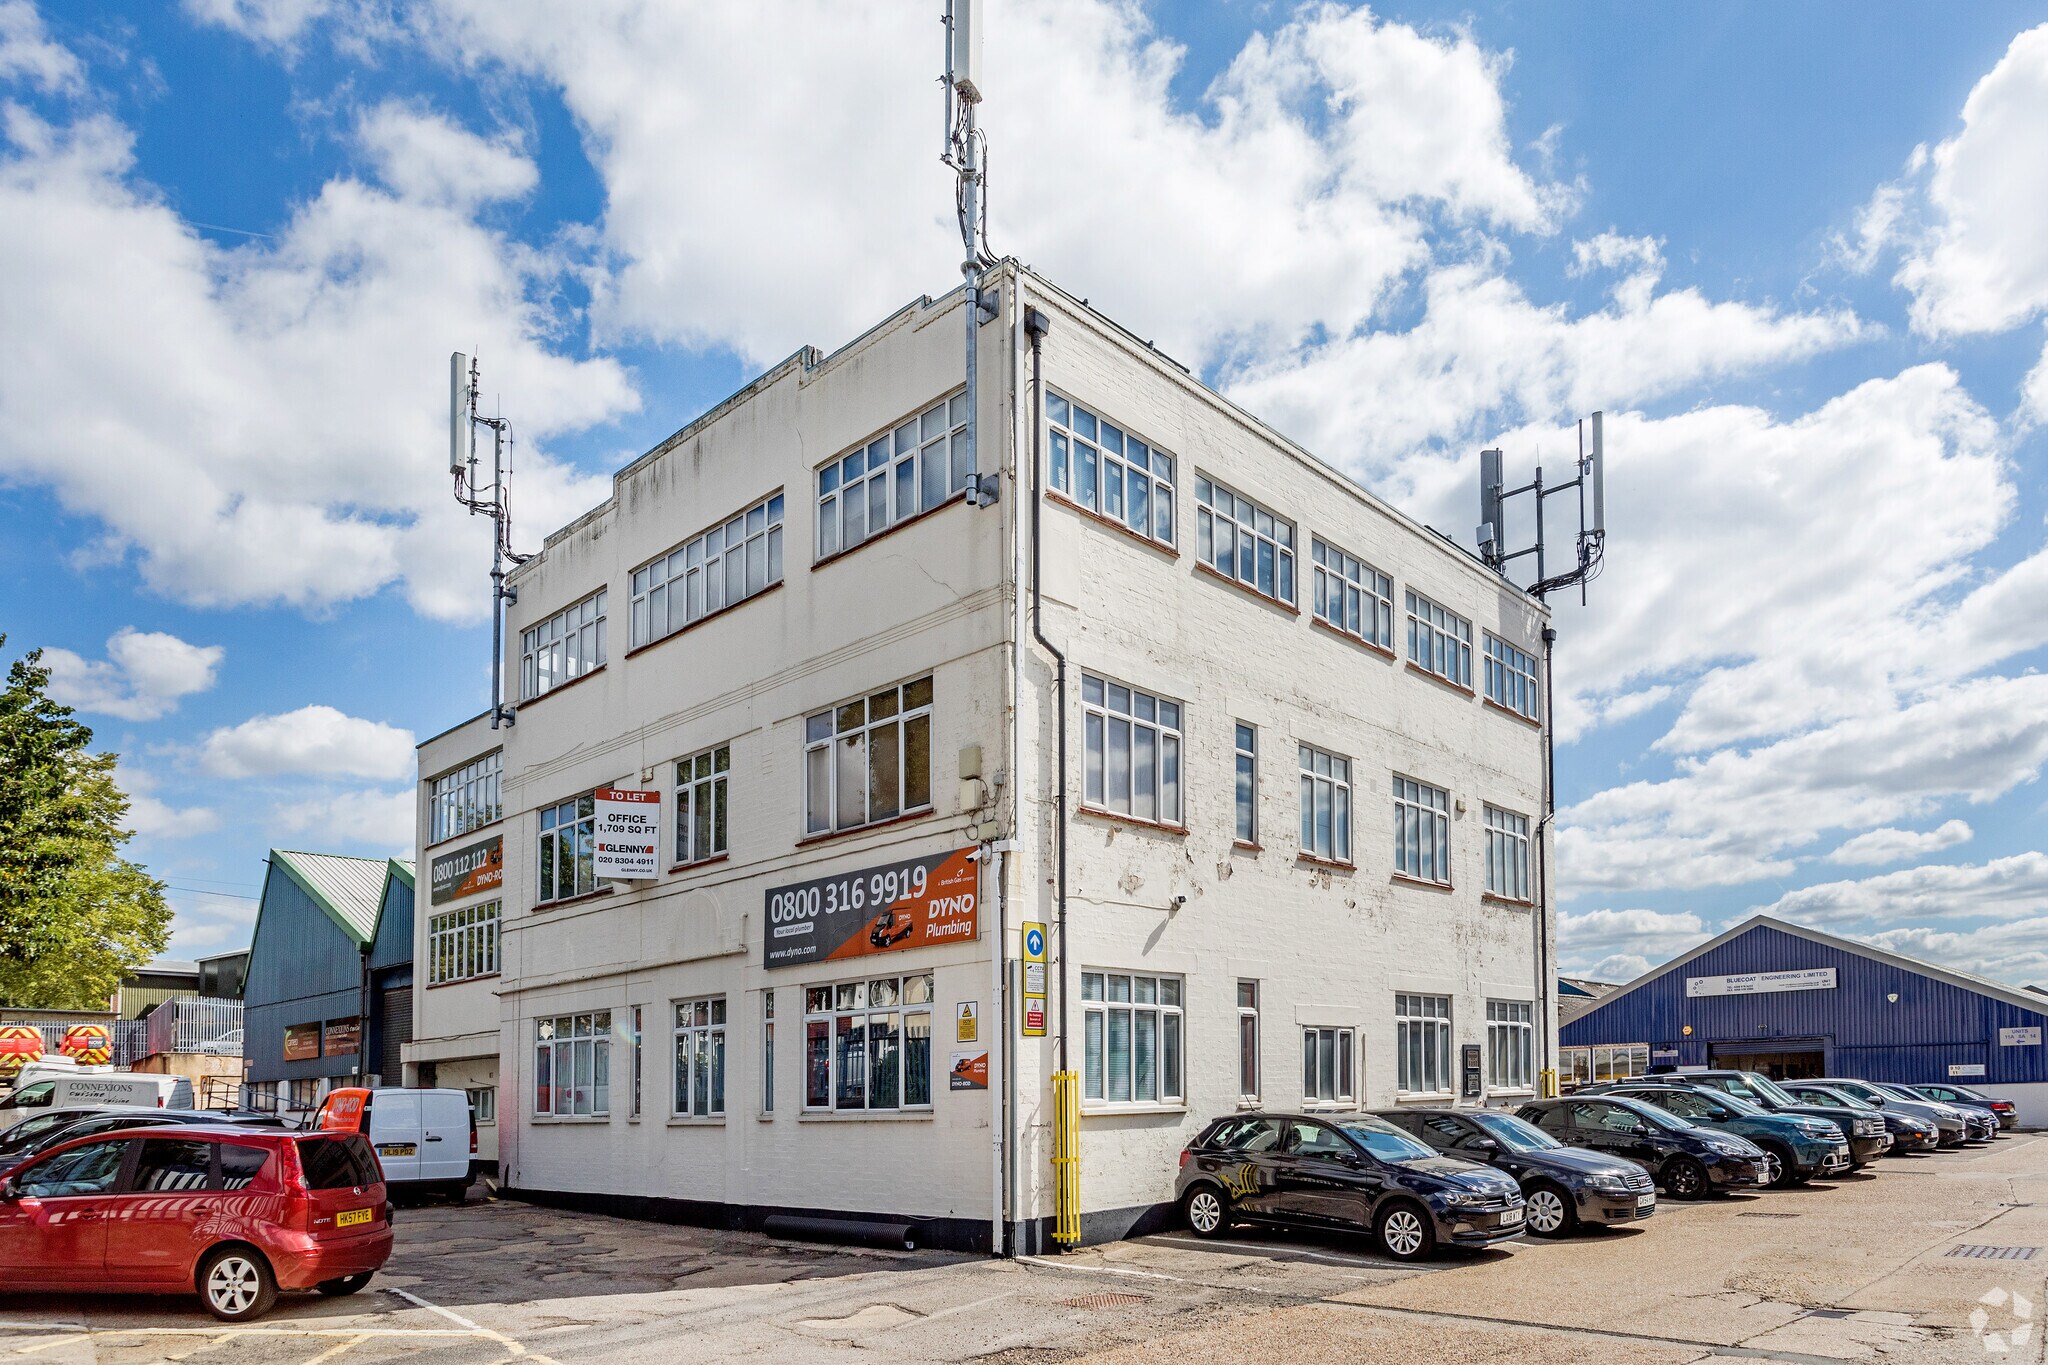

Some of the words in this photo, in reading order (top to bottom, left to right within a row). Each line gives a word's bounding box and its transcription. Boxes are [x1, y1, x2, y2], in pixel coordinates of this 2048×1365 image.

[610, 791, 623, 800] TO
[627, 793, 646, 801] LET
[608, 813, 647, 824] OFFICE
[598, 824, 625, 833] 1,709
[627, 826, 641, 834] SQ
[645, 826, 656, 834] FT
[605, 843, 646, 854] GLENNY
[433, 860, 453, 883] 0800
[454, 854, 470, 876] 112
[471, 848, 487, 870] 112
[476, 868, 503, 886] DYNO-RO
[771, 886, 820, 923] 0800
[825, 877, 865, 914] 316
[870, 865, 927, 906] 9919
[928, 893, 975, 919] DYNO
[898, 913, 911, 921] DYNO
[776, 927, 785, 935] Your
[785, 925, 795, 934] local
[795, 924, 812, 934] plumber
[926, 918, 972, 938] Plumbing
[769, 945, 817, 959] www.dyno.com
[1761, 973, 1801, 981] ENGINEERING
[325, 1024, 350, 1035] CONNEXIONS
[69, 1082, 133, 1092] CONNEXIONS
[69, 1090, 105, 1098] cuisine
[340, 1212, 356, 1224] HK57
[358, 1210, 369, 1222] FYE
